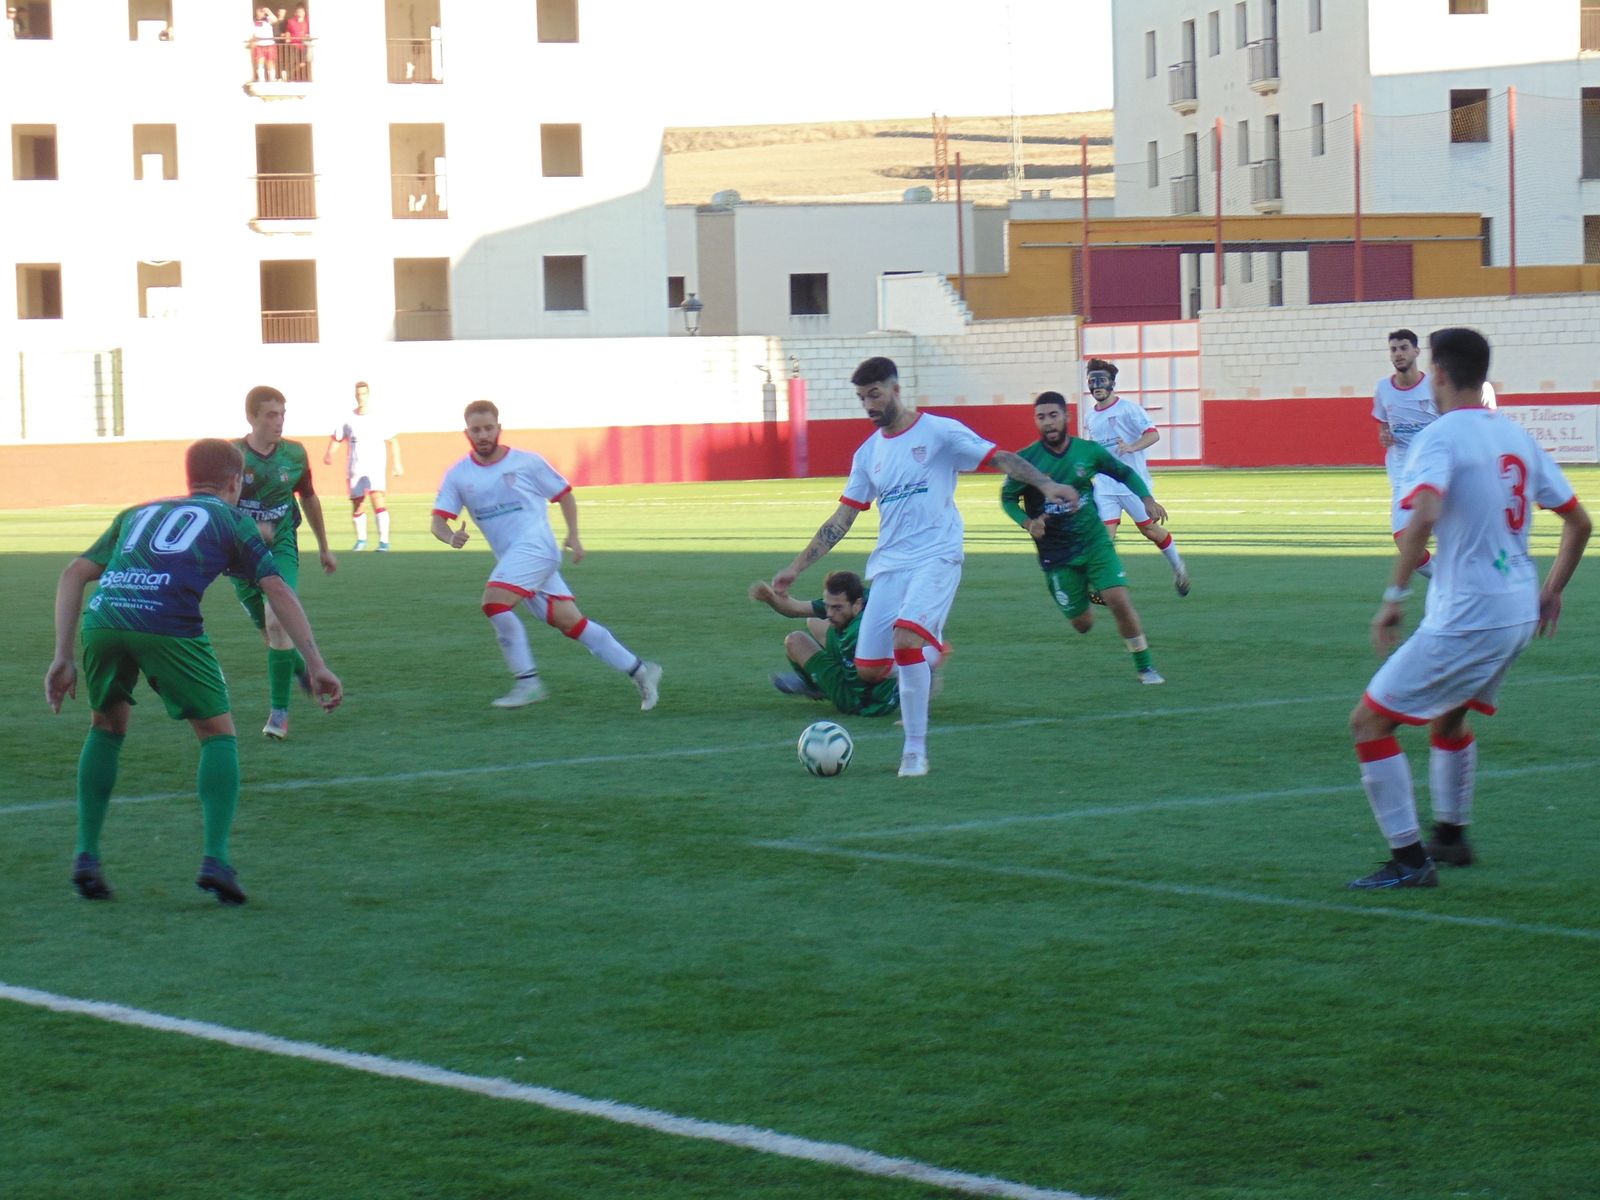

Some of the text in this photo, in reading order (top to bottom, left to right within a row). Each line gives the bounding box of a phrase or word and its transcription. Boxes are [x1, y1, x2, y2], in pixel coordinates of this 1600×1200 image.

[1529, 408, 1576, 421] Talleres
[1560, 427, 1583, 441] S.L.
[1497, 453, 1527, 535] 3
[120, 504, 209, 555] 10
